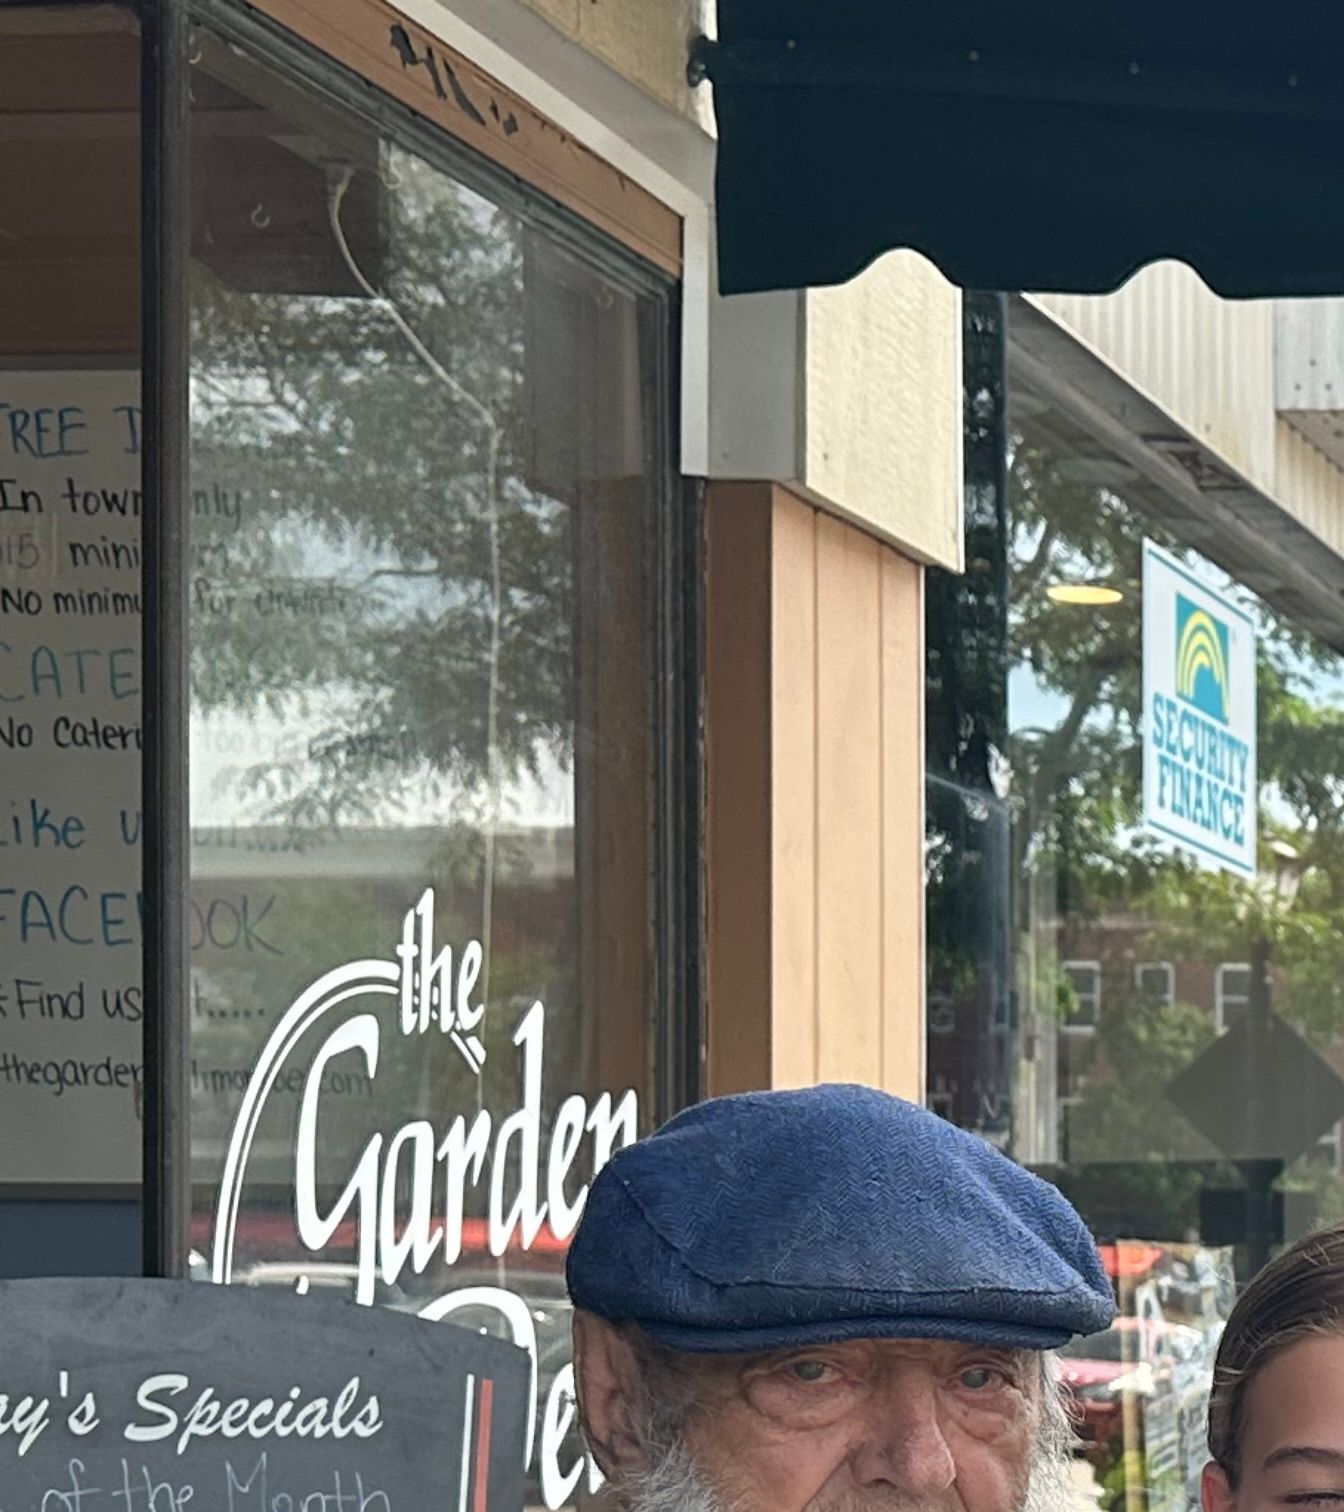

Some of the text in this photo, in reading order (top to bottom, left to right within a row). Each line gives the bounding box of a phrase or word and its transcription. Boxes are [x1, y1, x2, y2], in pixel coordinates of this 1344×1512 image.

[0, 402, 89, 458] REE
[1, 587, 42, 616] No
[53, 715, 142, 750] Cateri
[1153, 691, 1249, 793] SECURITY
[0, 798, 86, 849] ike
[1158, 752, 1245, 847] FINANCE
[397, 887, 487, 1037] the
[295, 1000, 640, 1306] Garden
[124, 1373, 385, 1456] Specials
